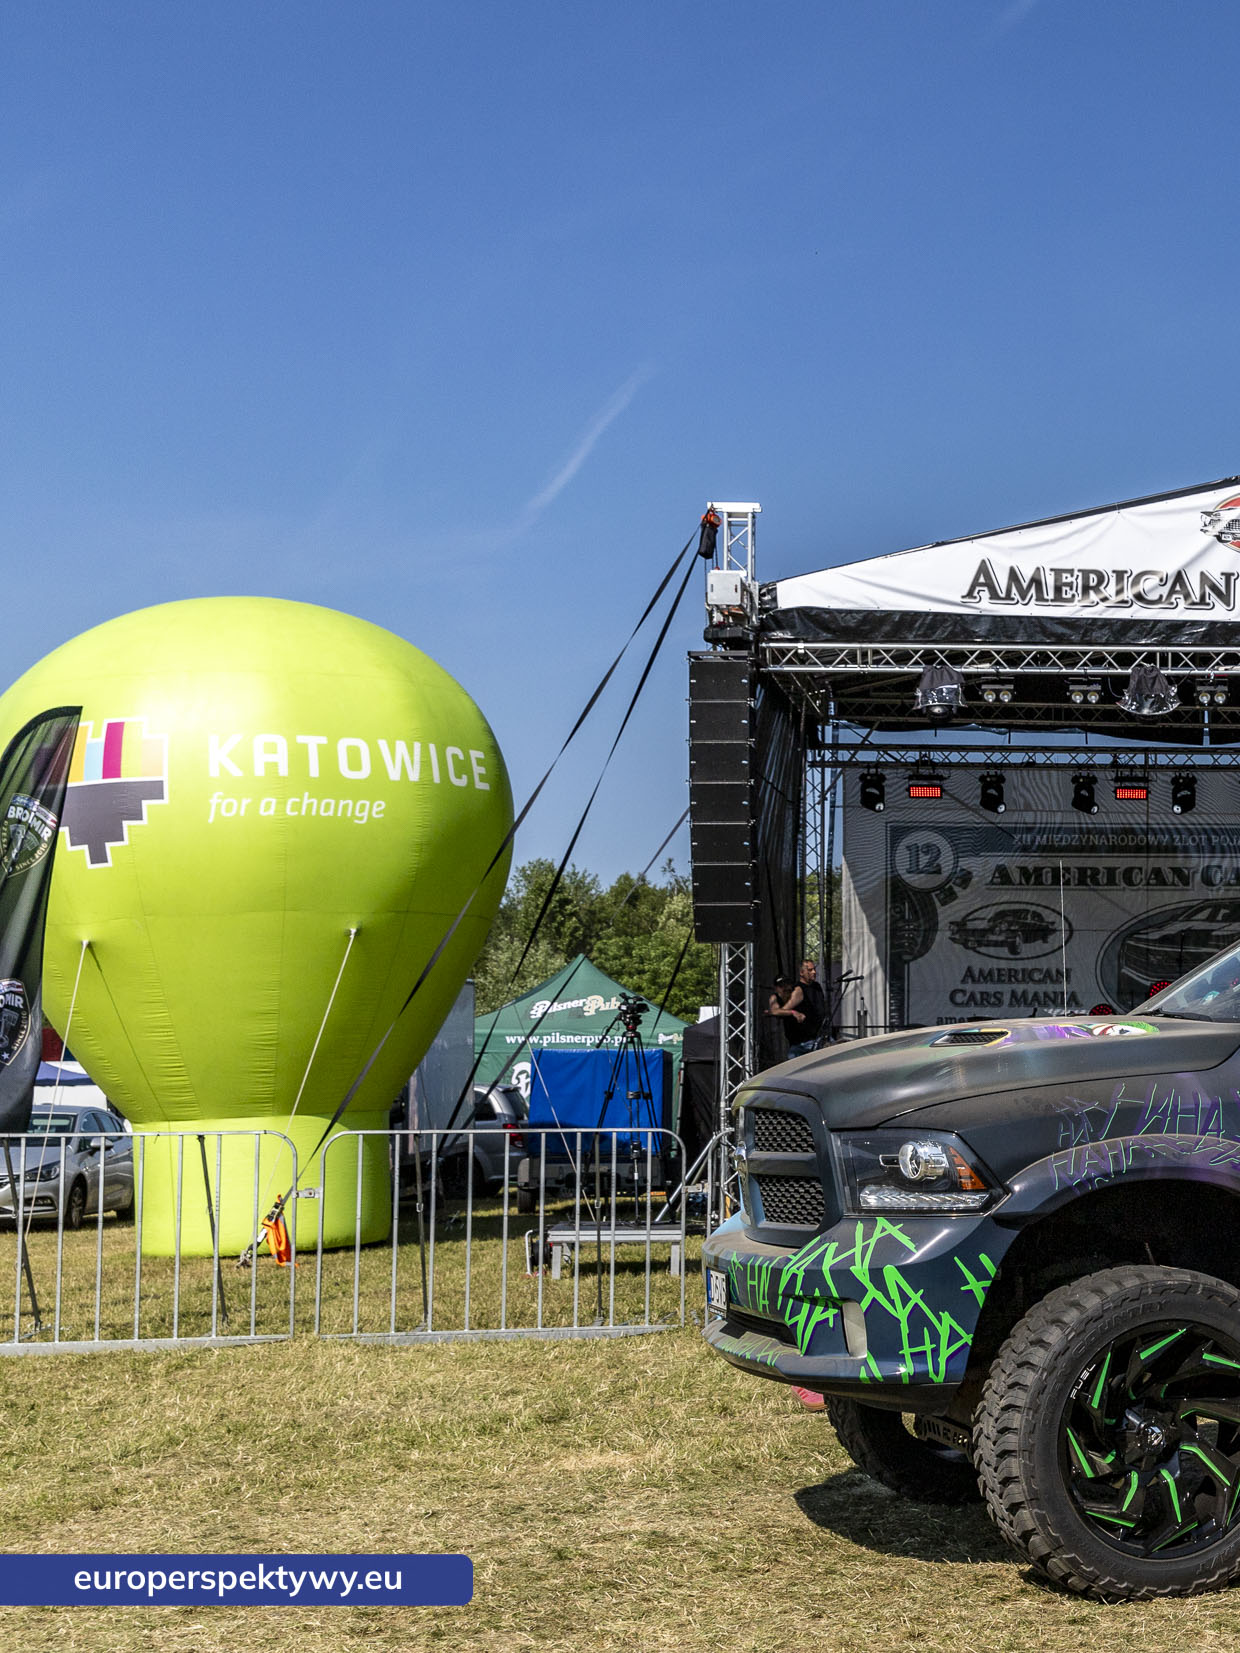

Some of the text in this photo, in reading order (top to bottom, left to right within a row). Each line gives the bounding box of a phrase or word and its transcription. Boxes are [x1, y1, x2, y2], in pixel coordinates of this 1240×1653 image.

[961, 558, 1240, 610] AMERICAN
[208, 733, 490, 790] KATOWICE
[208, 792, 386, 824] for a change
[904, 842, 943, 875] 12
[985, 863, 1193, 888] AMERICAN
[960, 966, 1073, 984] AMERICAN
[583, 995, 621, 1016] Pub
[949, 988, 1083, 1008] CARS MANIA
[1069, 1363, 1097, 1400] FUEL
